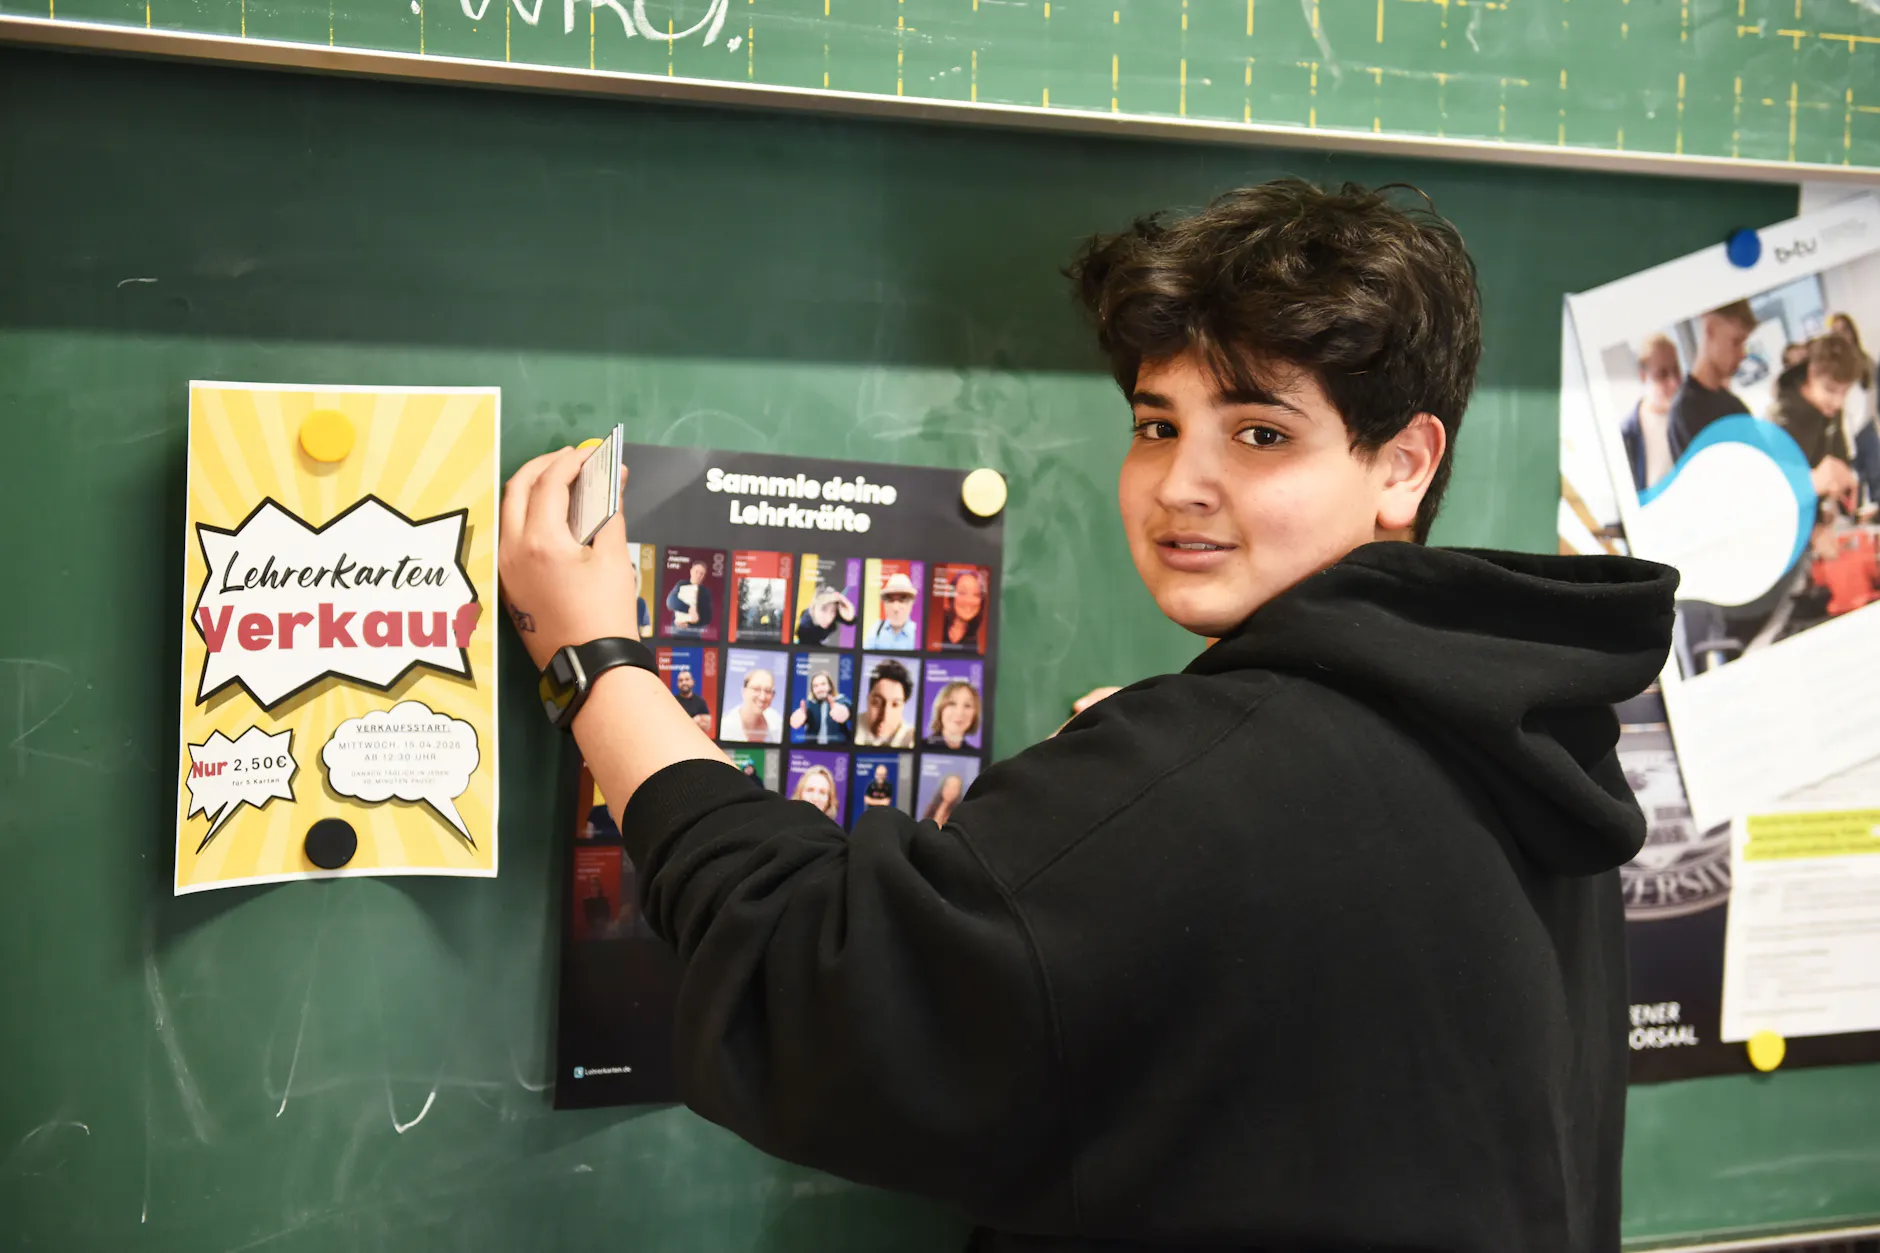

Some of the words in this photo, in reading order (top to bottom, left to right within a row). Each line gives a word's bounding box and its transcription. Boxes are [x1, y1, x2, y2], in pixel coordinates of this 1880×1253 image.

[706, 467, 821, 499] Sammle
[822, 476, 897, 505] deine
[729, 499, 871, 533] Lehrkräfte
[219, 550, 450, 595] Lehrerkarten
[198, 602, 479, 653] Verkauf
[192, 761, 228, 779] Nur
[233, 755, 287, 772] 2,50€
[364, 753, 378, 761] AB
[415, 753, 436, 761] UHR
